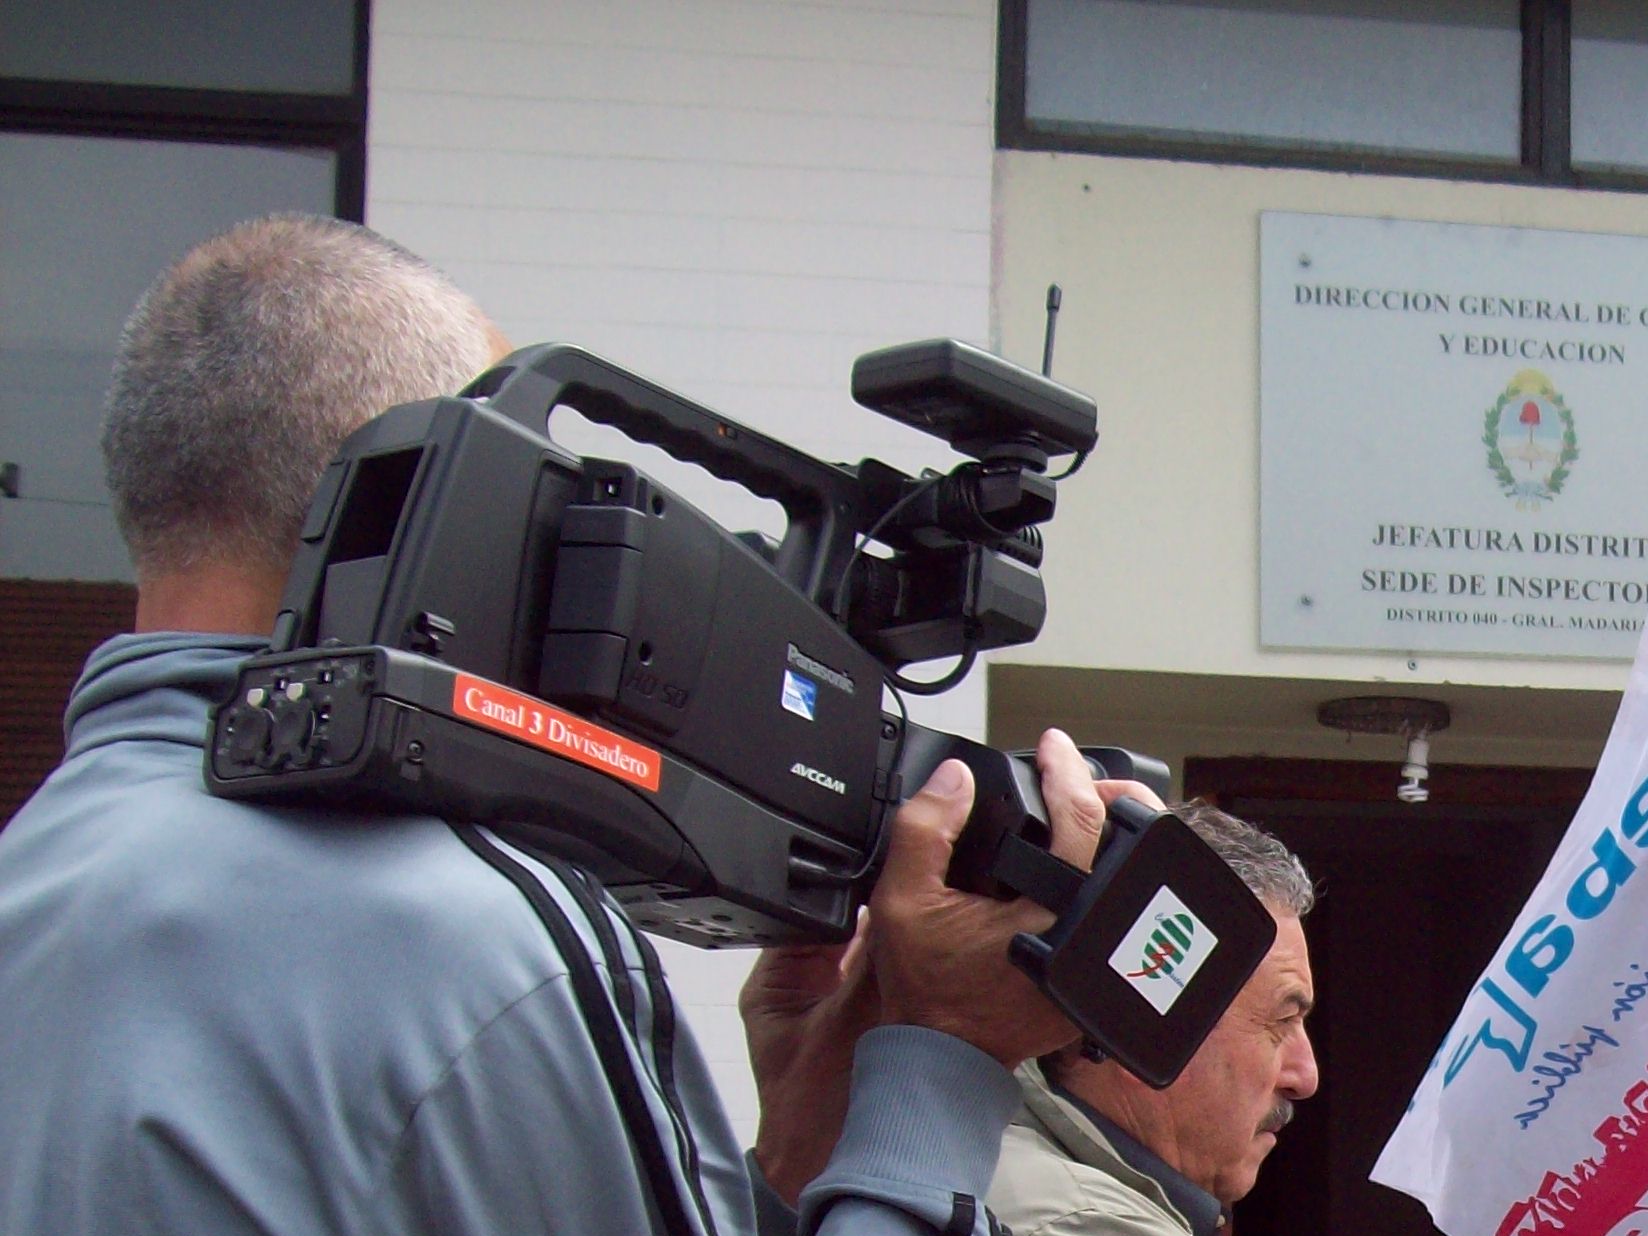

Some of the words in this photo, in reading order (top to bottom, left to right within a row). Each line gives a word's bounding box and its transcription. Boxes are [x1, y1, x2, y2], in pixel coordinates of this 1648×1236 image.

[1294, 284, 1450, 314] DIRECCION
[1459, 295, 1588, 324] GENERAL
[1597, 304, 1631, 326] DE
[1439, 333, 1453, 354] Y
[1464, 336, 1625, 365] EDUCACION
[1372, 524, 1524, 552] JEFATURA
[1361, 569, 1438, 593] SEDE
[1448, 573, 1486, 596] DE
[1386, 607, 1468, 625] DISTRITO
[1472, 611, 1498, 625] 040
[1511, 613, 1563, 629] GRAL.
[787, 642, 854, 694] Panasonic
[465, 687, 525, 728] Canal
[528, 711, 544, 735] 3
[548, 718, 649, 779] Divisadero
[790, 762, 846, 795] AVCCAM
